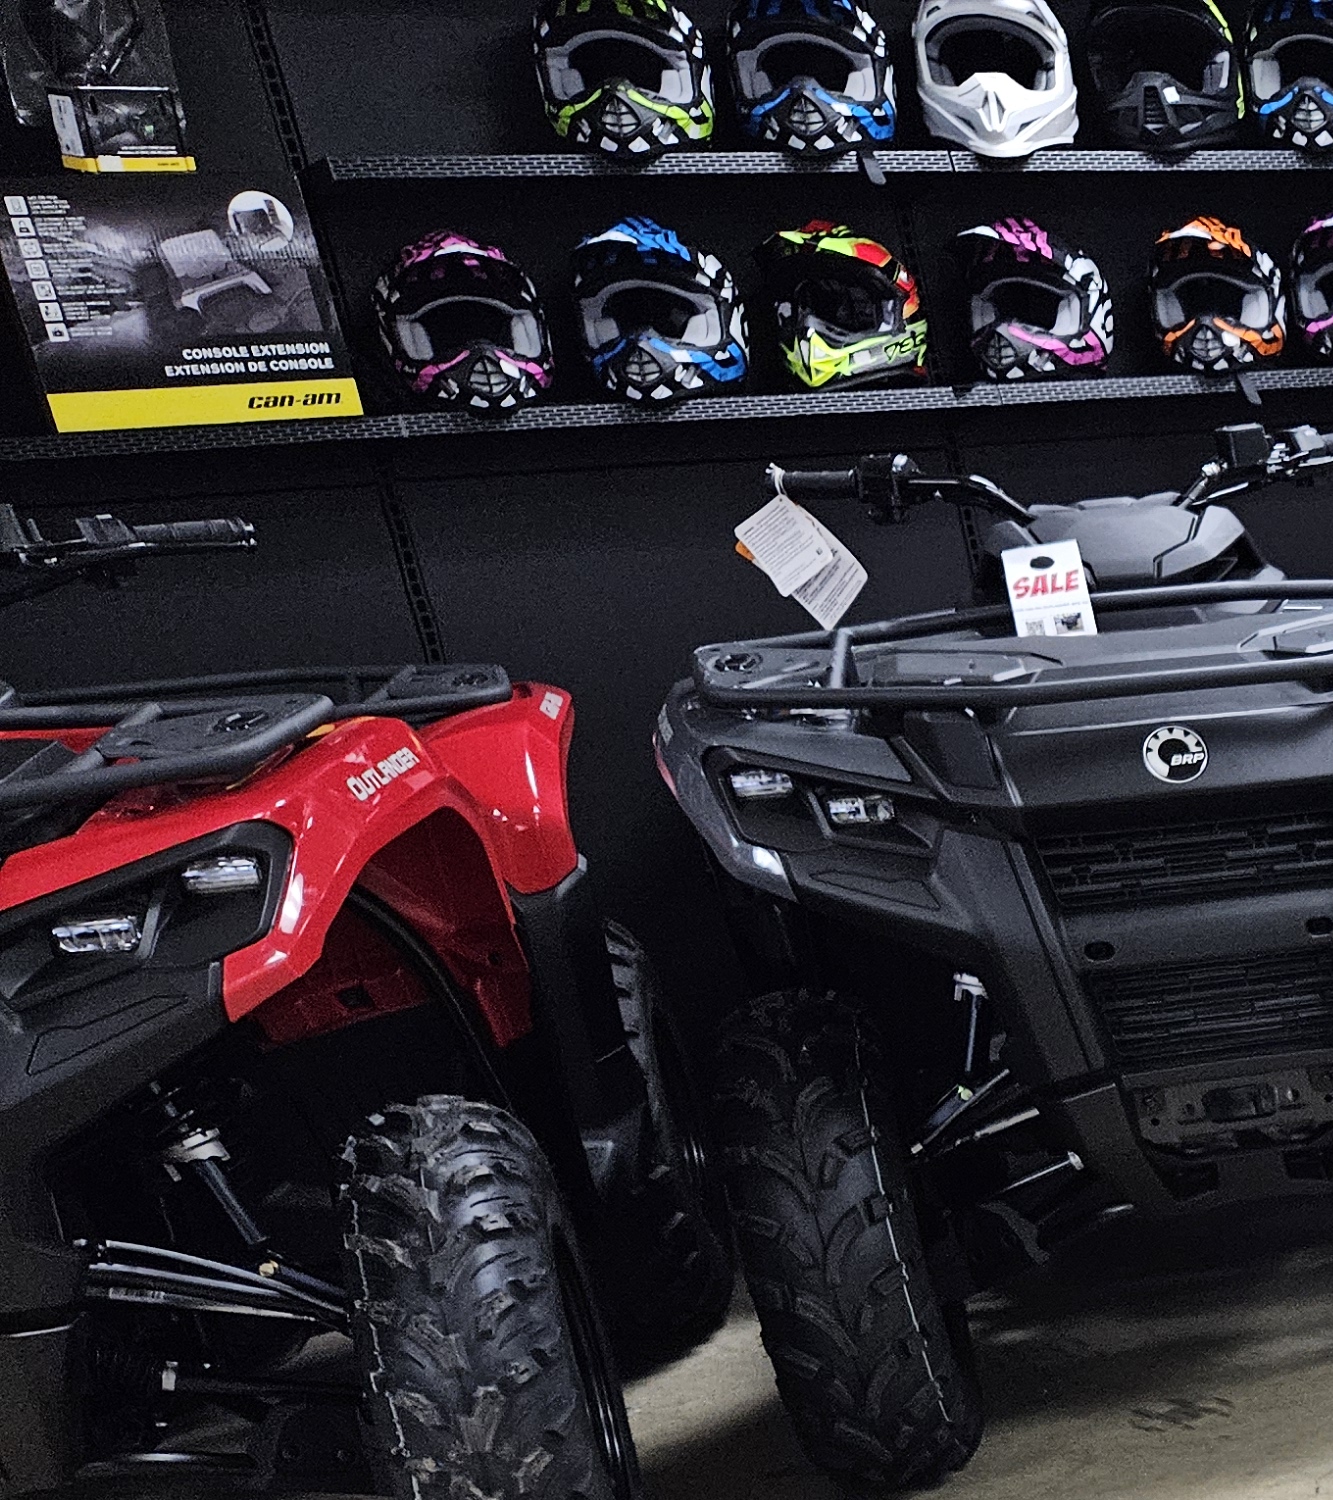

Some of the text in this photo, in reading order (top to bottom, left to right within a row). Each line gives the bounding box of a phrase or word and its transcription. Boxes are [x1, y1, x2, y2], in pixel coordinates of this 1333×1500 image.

[182, 342, 330, 361] CONSOLE EXTENSION
[164, 357, 335, 377] EXTENSION DE CONSOLE
[248, 392, 342, 409] can-am
[1012, 569, 1079, 600] SALE
[1170, 752, 1205, 767] BRP
